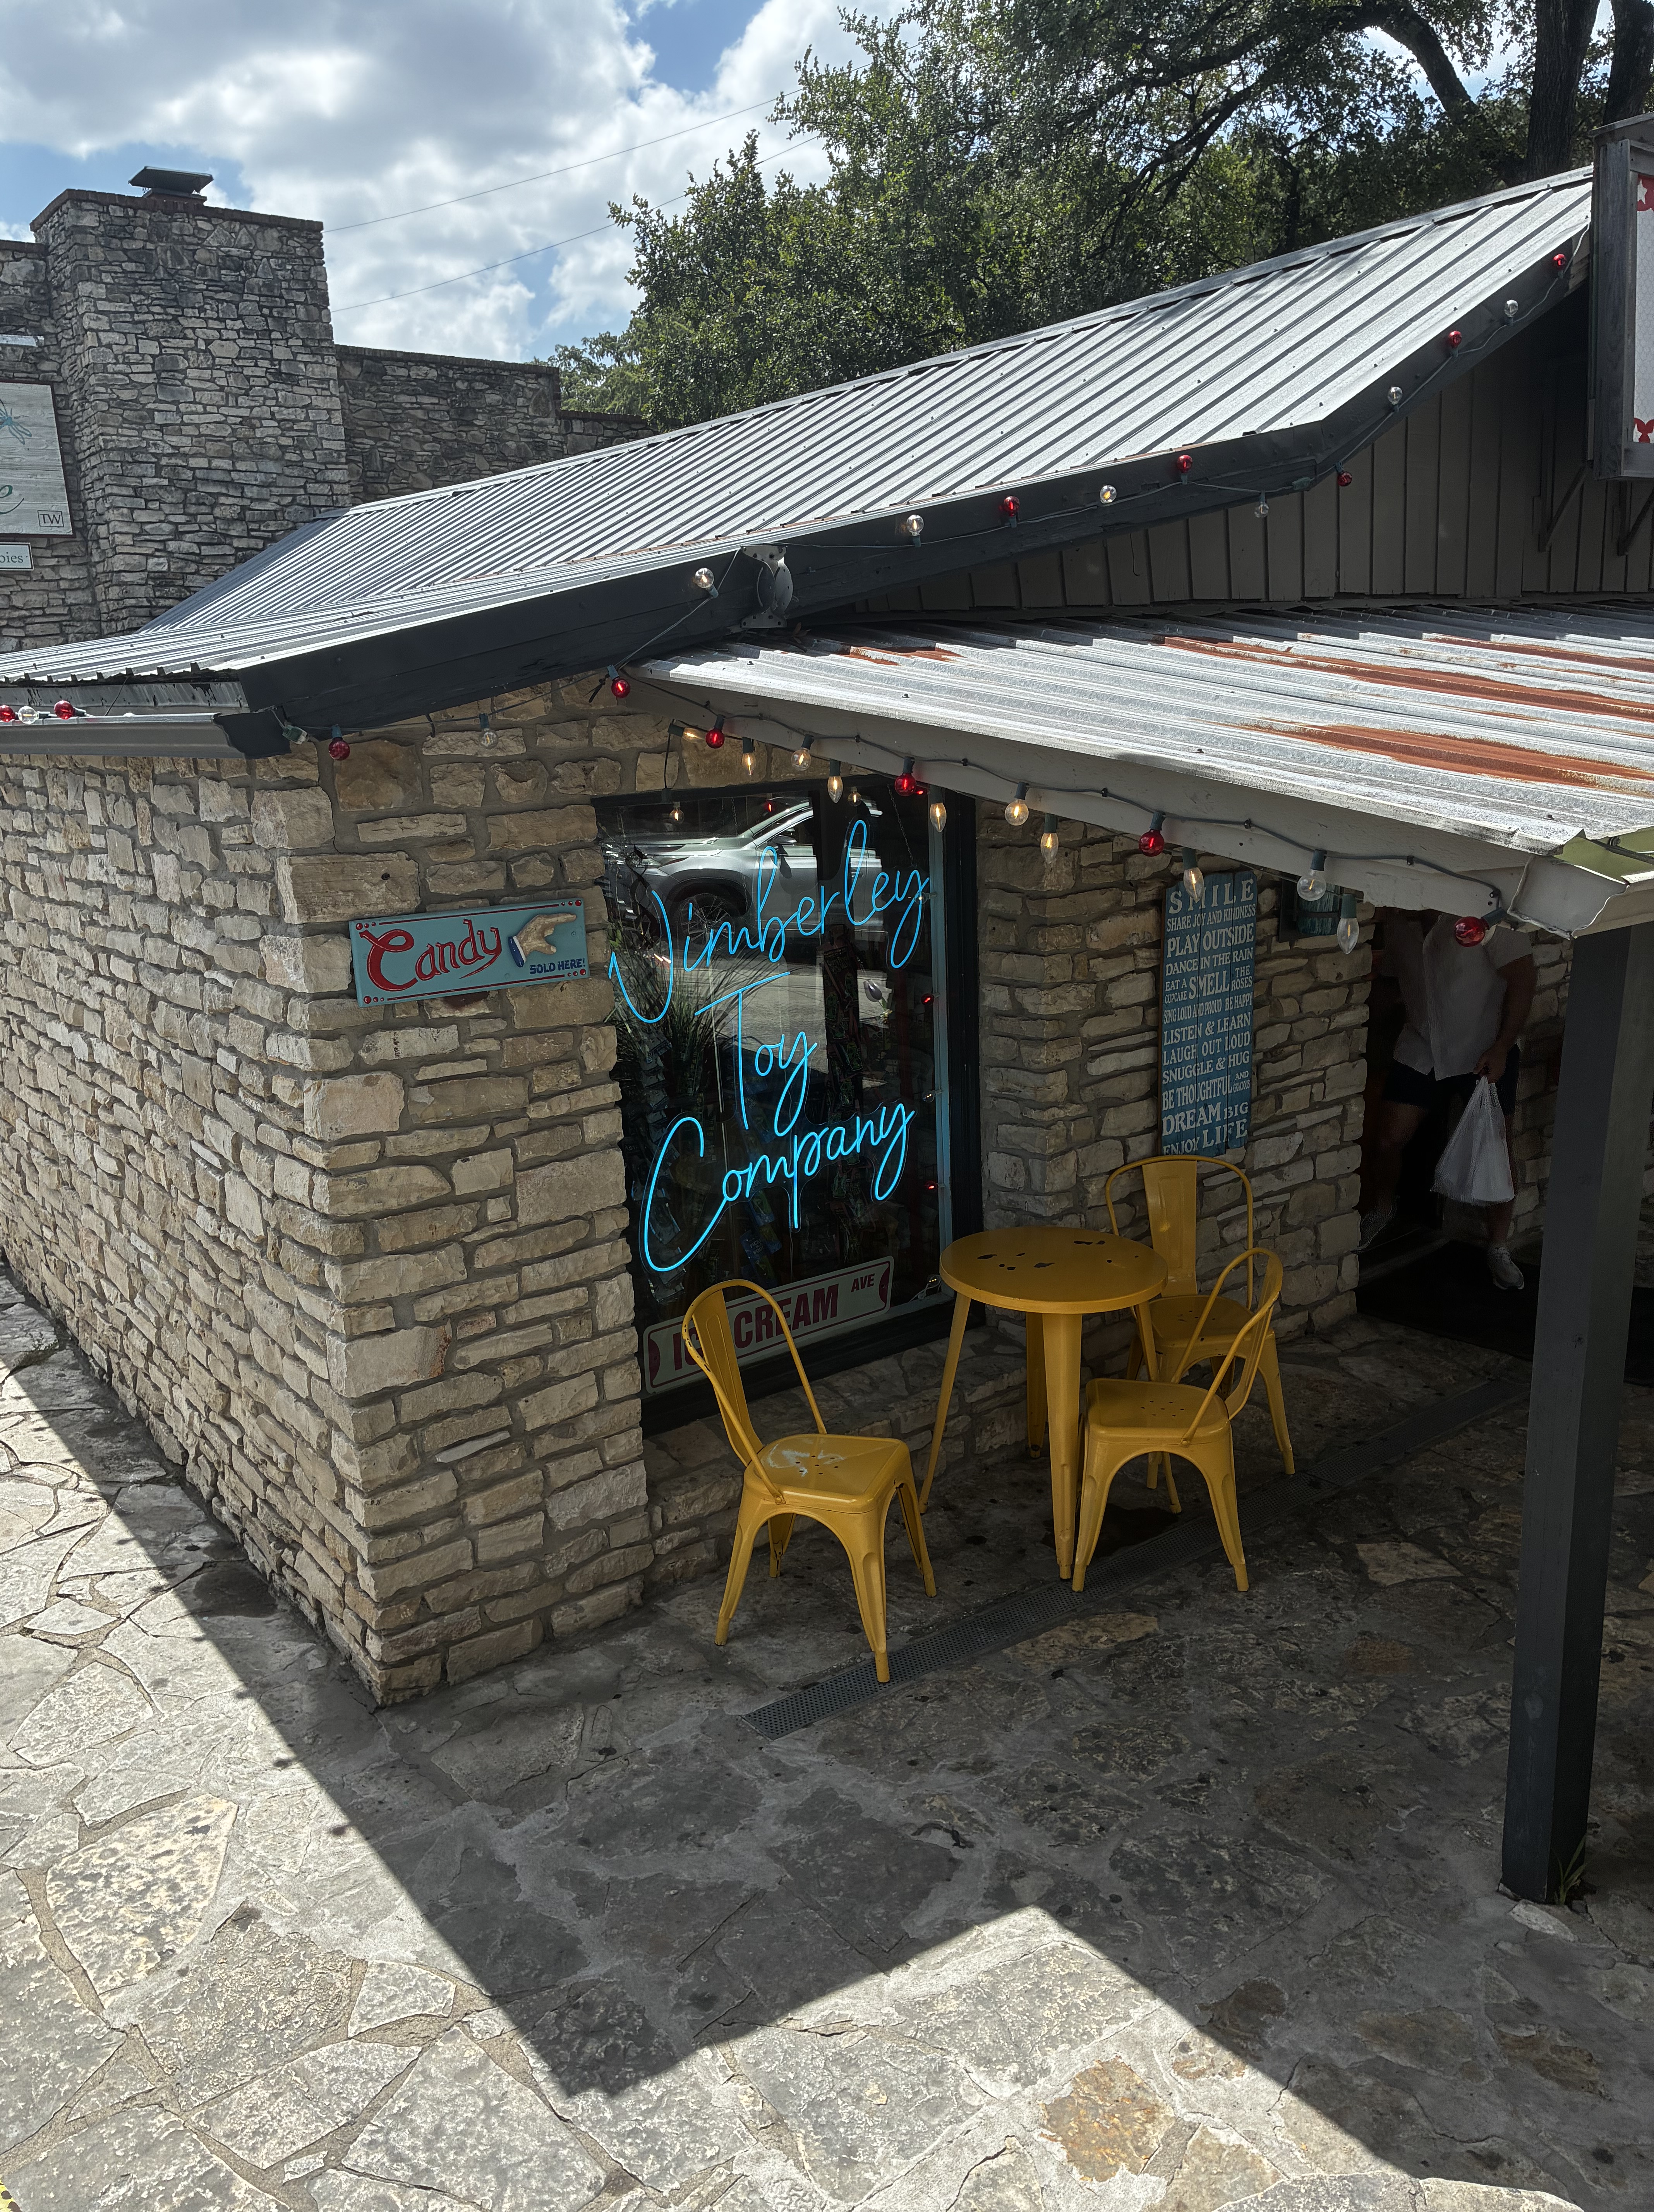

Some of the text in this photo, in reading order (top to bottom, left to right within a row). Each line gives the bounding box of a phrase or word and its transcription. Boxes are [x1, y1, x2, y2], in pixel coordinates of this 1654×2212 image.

[40, 514, 60, 524] TW
[1169, 879, 1254, 914] SMILE
[1167, 903, 1256, 932] SHARE JOY AND KINDNESS
[359, 919, 502, 991] Candy
[1167, 923, 1254, 958] PLAY OUTSIDE
[529, 958, 585, 975] SOLD HERE!
[1165, 947, 1253, 976] DANCE IN THE RAIN
[1235, 965, 1250, 978] THE
[1165, 978, 1187, 991] EAT A
[1165, 991, 1187, 1004] CUPCAKE
[1189, 970, 1230, 999] SMELL
[1231, 976, 1253, 991] ROSES
[1163, 992, 1253, 1024] SING LOUD AND PROUD BE HAPPY
[1164, 1012, 1251, 1046] LISTEN & LEARN
[694, 972, 817, 1137] Toy
[1163, 1031, 1251, 1066] LAUGH OUT LOUD
[1162, 1051, 1249, 1084] SNUGGLE & HUG
[1235, 1071, 1249, 1080] AND
[1162, 1075, 1232, 1111] BE THOUGHTFUL
[1233, 1080, 1250, 1092] GRACIOUS
[1162, 1101, 1249, 1136] DREAM BIG
[1163, 1118, 1247, 1155] ENJOY LIFE
[644, 1103, 915, 1272] Company
[734, 1283, 839, 1348] CREAM
[851, 1274, 875, 1292] AVE
